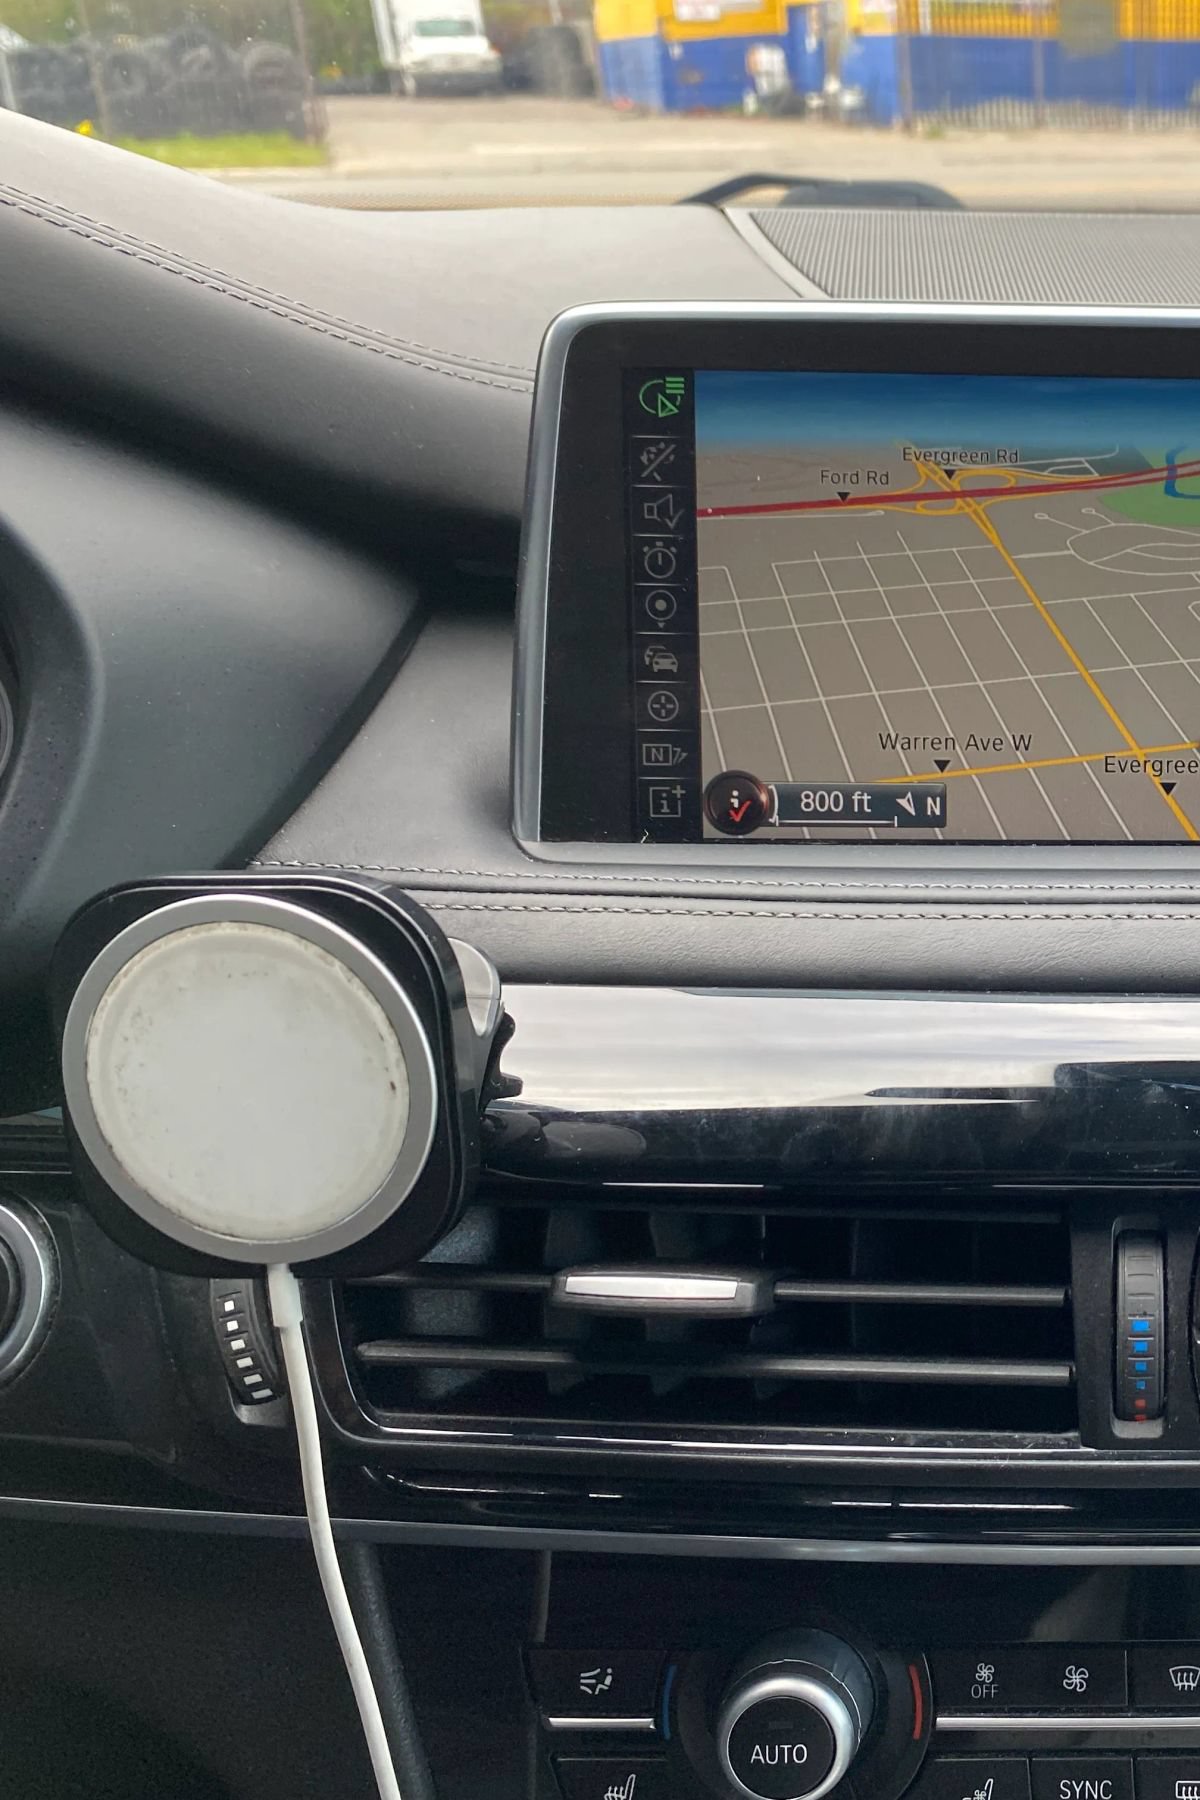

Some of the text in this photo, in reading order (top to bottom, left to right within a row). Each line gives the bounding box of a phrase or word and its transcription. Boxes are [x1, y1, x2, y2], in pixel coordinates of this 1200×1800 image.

[902, 447, 1019, 465] Evergreen Rd
[820, 470, 889, 486] Ford Rd
[879, 733, 1032, 751] Warren Ave W
[800, 790, 872, 813] 800 ft
[926, 796, 941, 816] N
[970, 1683, 999, 1699] OFF
[750, 1744, 808, 1765] AUTO
[1059, 1779, 1113, 1800] SYNC
